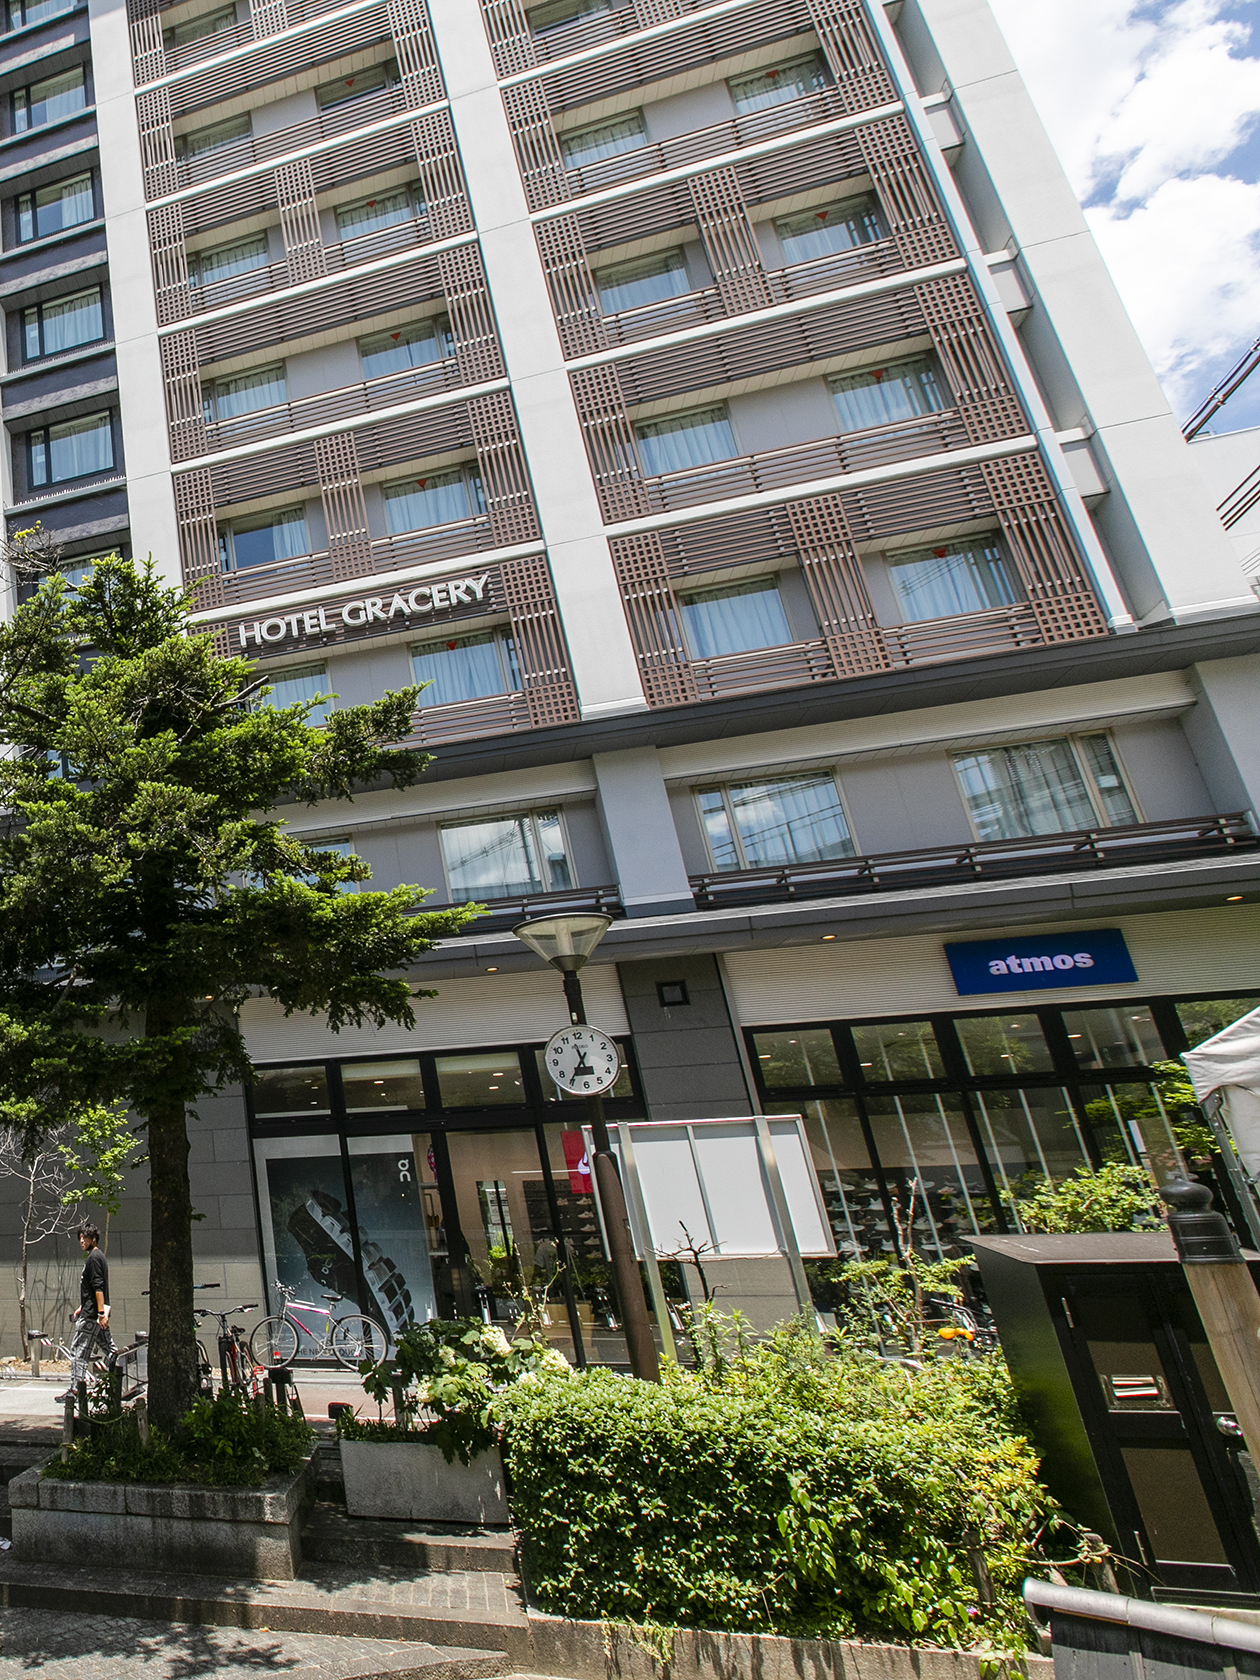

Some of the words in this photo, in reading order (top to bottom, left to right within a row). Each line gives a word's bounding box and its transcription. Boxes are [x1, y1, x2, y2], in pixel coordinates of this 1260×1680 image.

[238, 608, 336, 648] HOTEL
[342, 575, 489, 626] GRACERY
[988, 952, 1095, 976] atmos
[572, 1032, 583, 1040] 12
[589, 1034, 594, 1042] 1
[561, 1037, 570, 1045] 11
[600, 1042, 607, 1050] 2
[553, 1046, 563, 1055] 10
[606, 1054, 613, 1062] 3
[552, 1059, 559, 1067] 9
[559, 1070, 565, 1078] 8
[605, 1067, 612, 1075] 4
[583, 1081, 590, 1089] 6
[597, 1077, 603, 1085] 5
